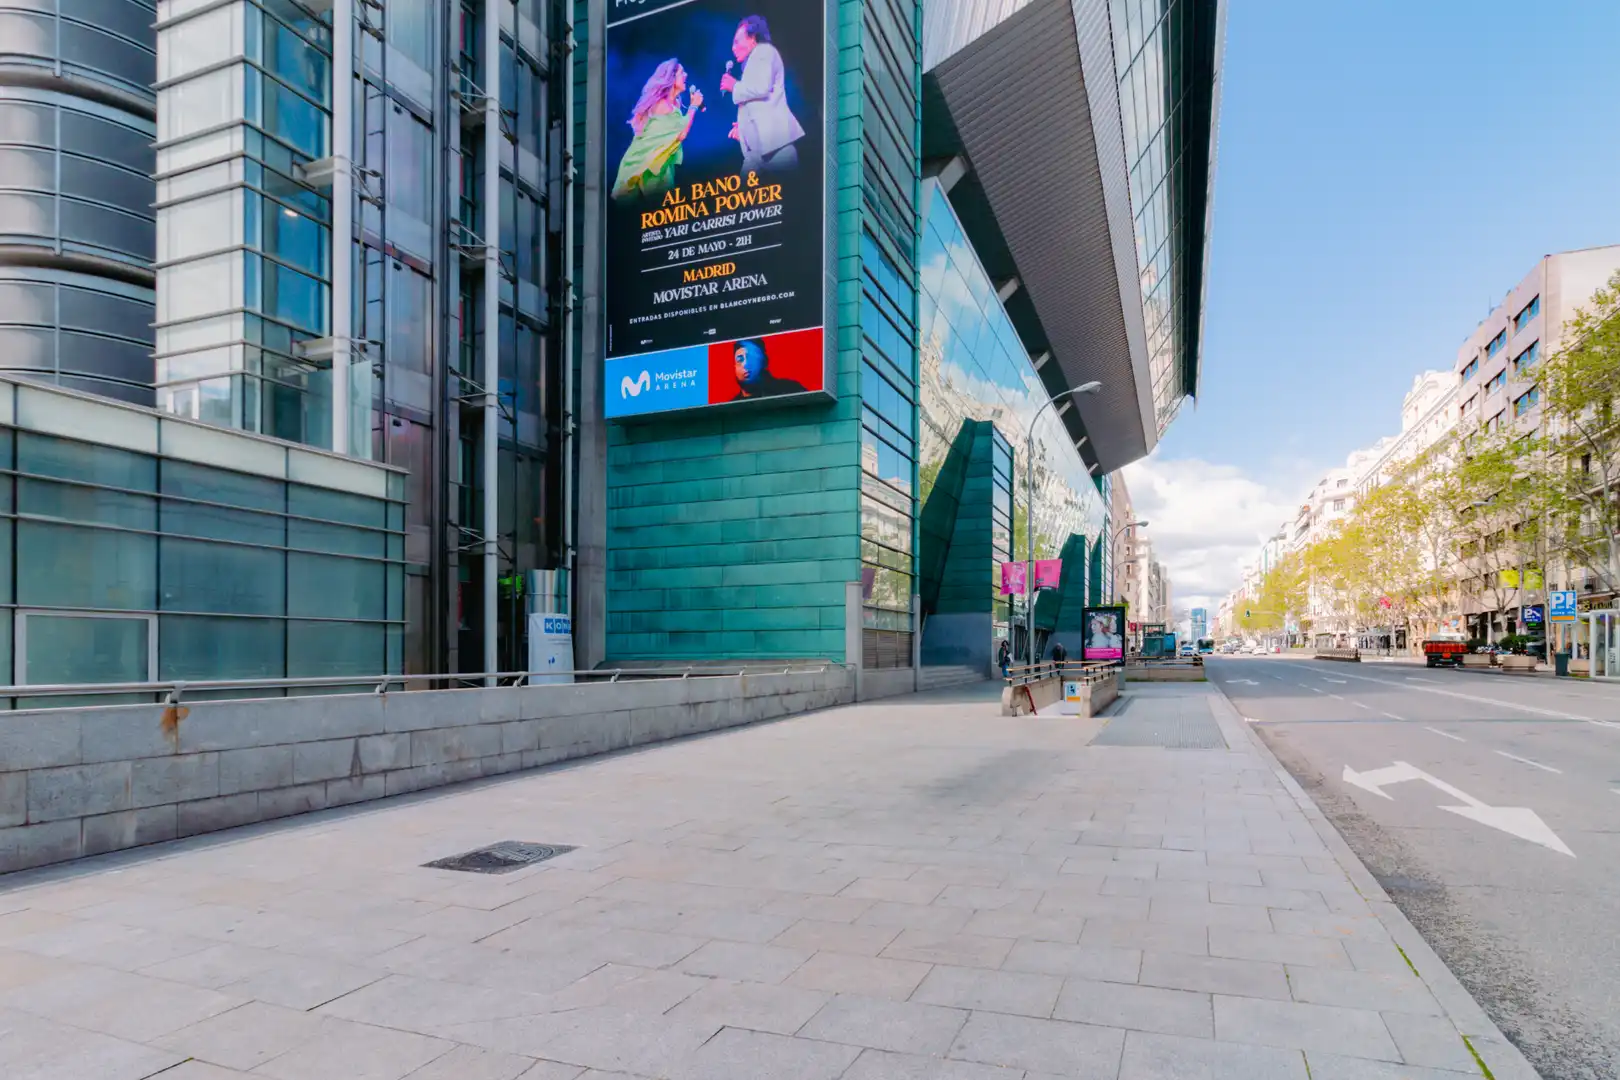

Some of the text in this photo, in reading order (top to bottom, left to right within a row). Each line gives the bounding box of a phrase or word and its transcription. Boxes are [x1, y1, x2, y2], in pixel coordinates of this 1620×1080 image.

[662, 171, 759, 206] AL BANO &
[641, 184, 783, 229] ROMINA POWER
[664, 204, 783, 239] YARI CARRISI POWER
[667, 249, 679, 260] 24
[682, 246, 695, 257] DE
[697, 240, 727, 255] MAYO
[735, 234, 752, 247] 21H
[682, 262, 736, 283] MADRID
[653, 273, 768, 305] MOVISTAR ARENA
[629, 314, 662, 324] ENTRADAS
[664, 306, 707, 319] DISPONIBLES
[720, 291, 795, 309] BLANCOYNEGRO.COM
[655, 369, 697, 382] Movistar
[655, 379, 696, 391] ARENA
